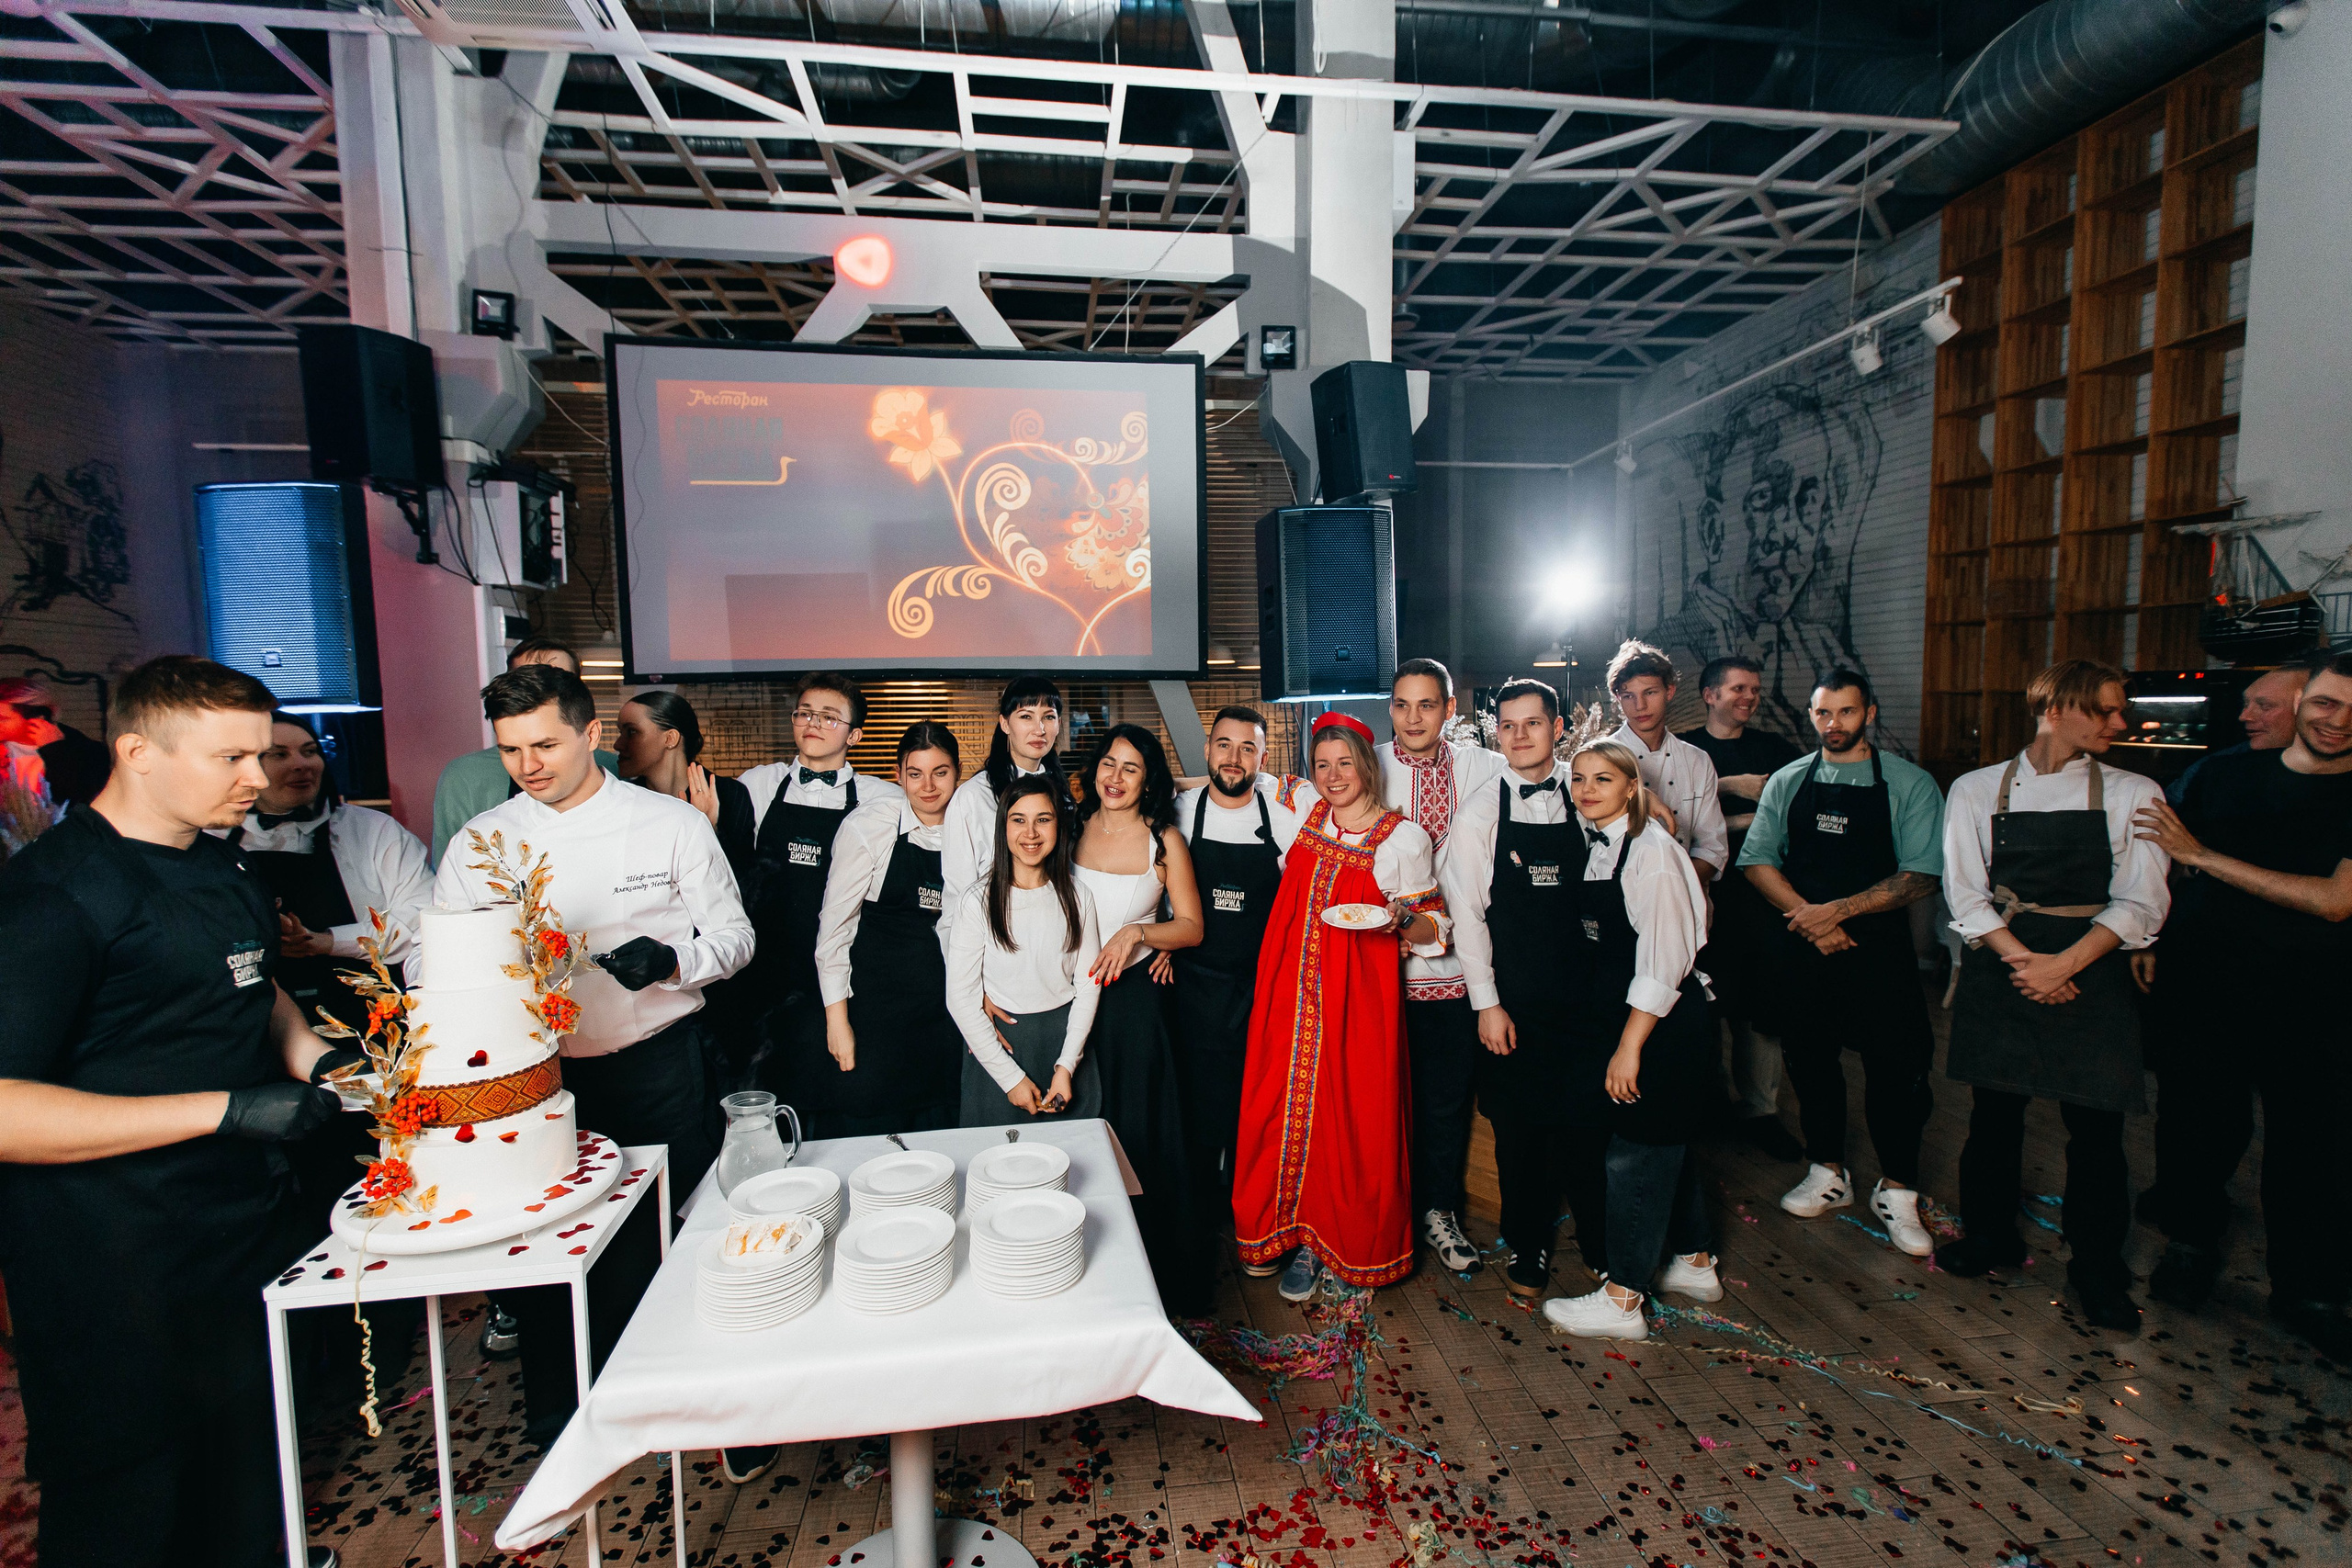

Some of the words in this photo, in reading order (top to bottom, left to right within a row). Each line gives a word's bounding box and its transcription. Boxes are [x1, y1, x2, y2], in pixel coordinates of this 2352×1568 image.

[687, 388, 768, 410] Ресторан
[1818, 820, 1844, 831] БИРЖА
[788, 842, 821, 855] СОЛЯНАЯ
[790, 852, 817, 863] БИРЖА
[1528, 865, 1559, 874] СОЛЯНАЯ
[626, 871, 669, 883] Шеф-повар
[1532, 874, 1558, 883] БИРЖА
[918, 886, 941, 899] СОЛЯН
[1213, 888, 1245, 900] СОЛЯНАЯ
[920, 896, 942, 908] БИРЖ
[1215, 897, 1241, 908] БИРЖА
